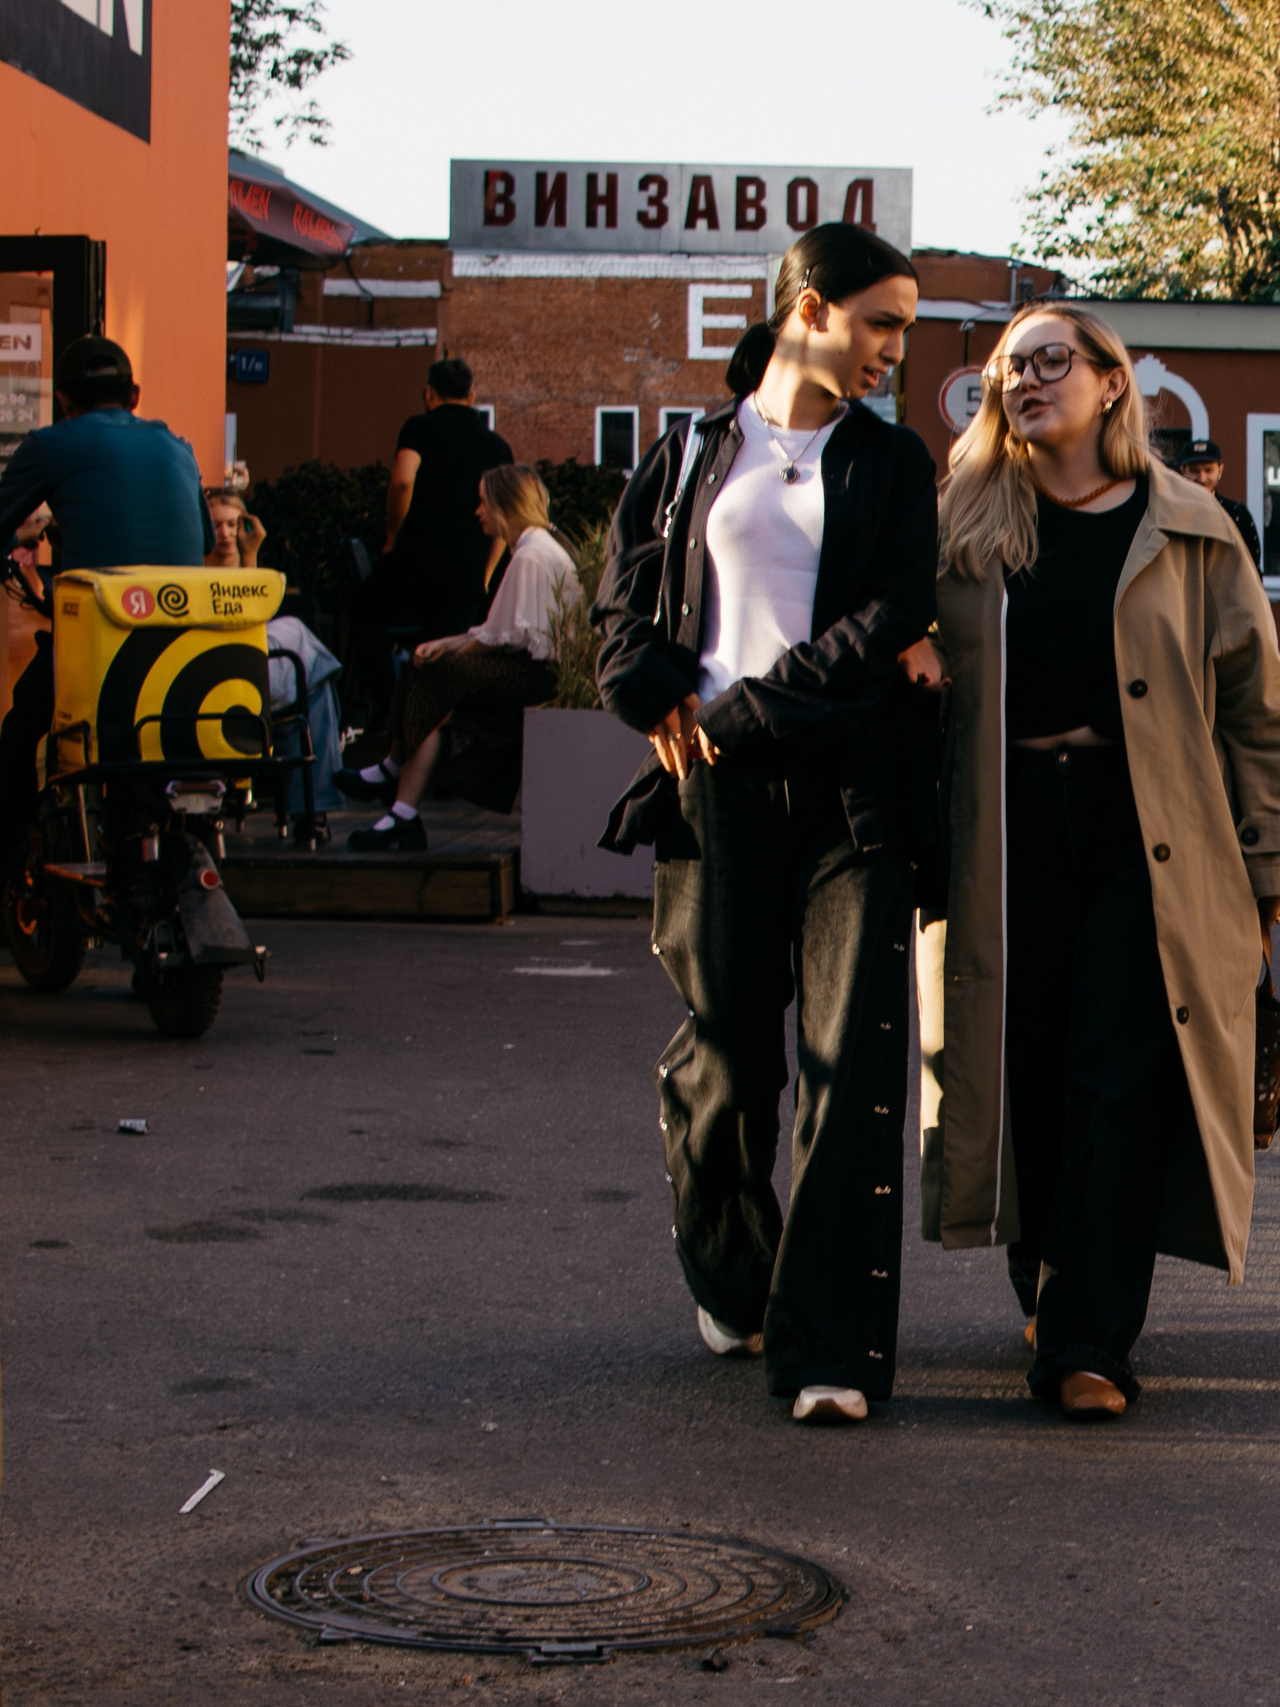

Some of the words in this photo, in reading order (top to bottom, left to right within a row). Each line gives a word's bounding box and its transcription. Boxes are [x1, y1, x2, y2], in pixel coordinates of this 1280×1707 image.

[483, 169, 877, 232] ВИНЗАВОД
[966, 386, 983, 418] 5
[210, 581, 269, 598] Яндекс
[212, 598, 243, 616] Еда
